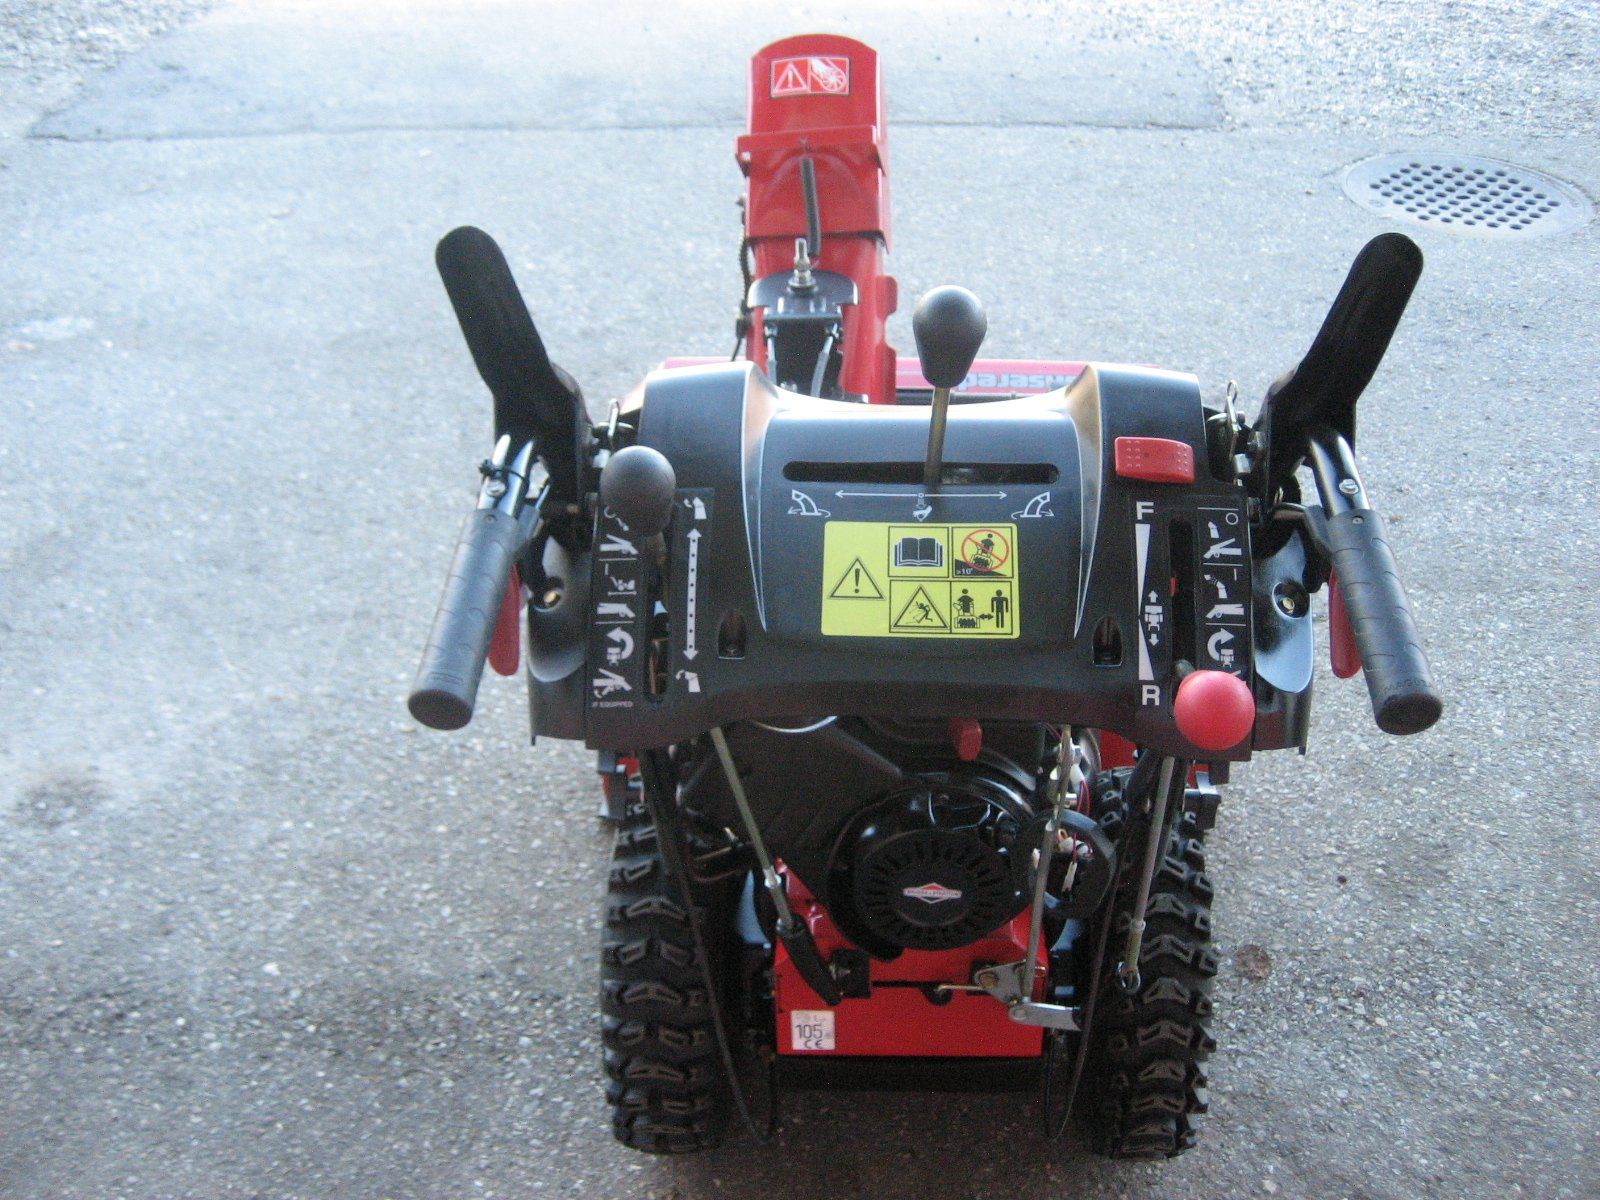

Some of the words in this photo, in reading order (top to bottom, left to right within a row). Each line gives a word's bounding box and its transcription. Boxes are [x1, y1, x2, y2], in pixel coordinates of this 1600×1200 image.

[1136, 501, 1154, 520] F
[1141, 684, 1160, 706] R
[795, 1023, 823, 1040] 105
